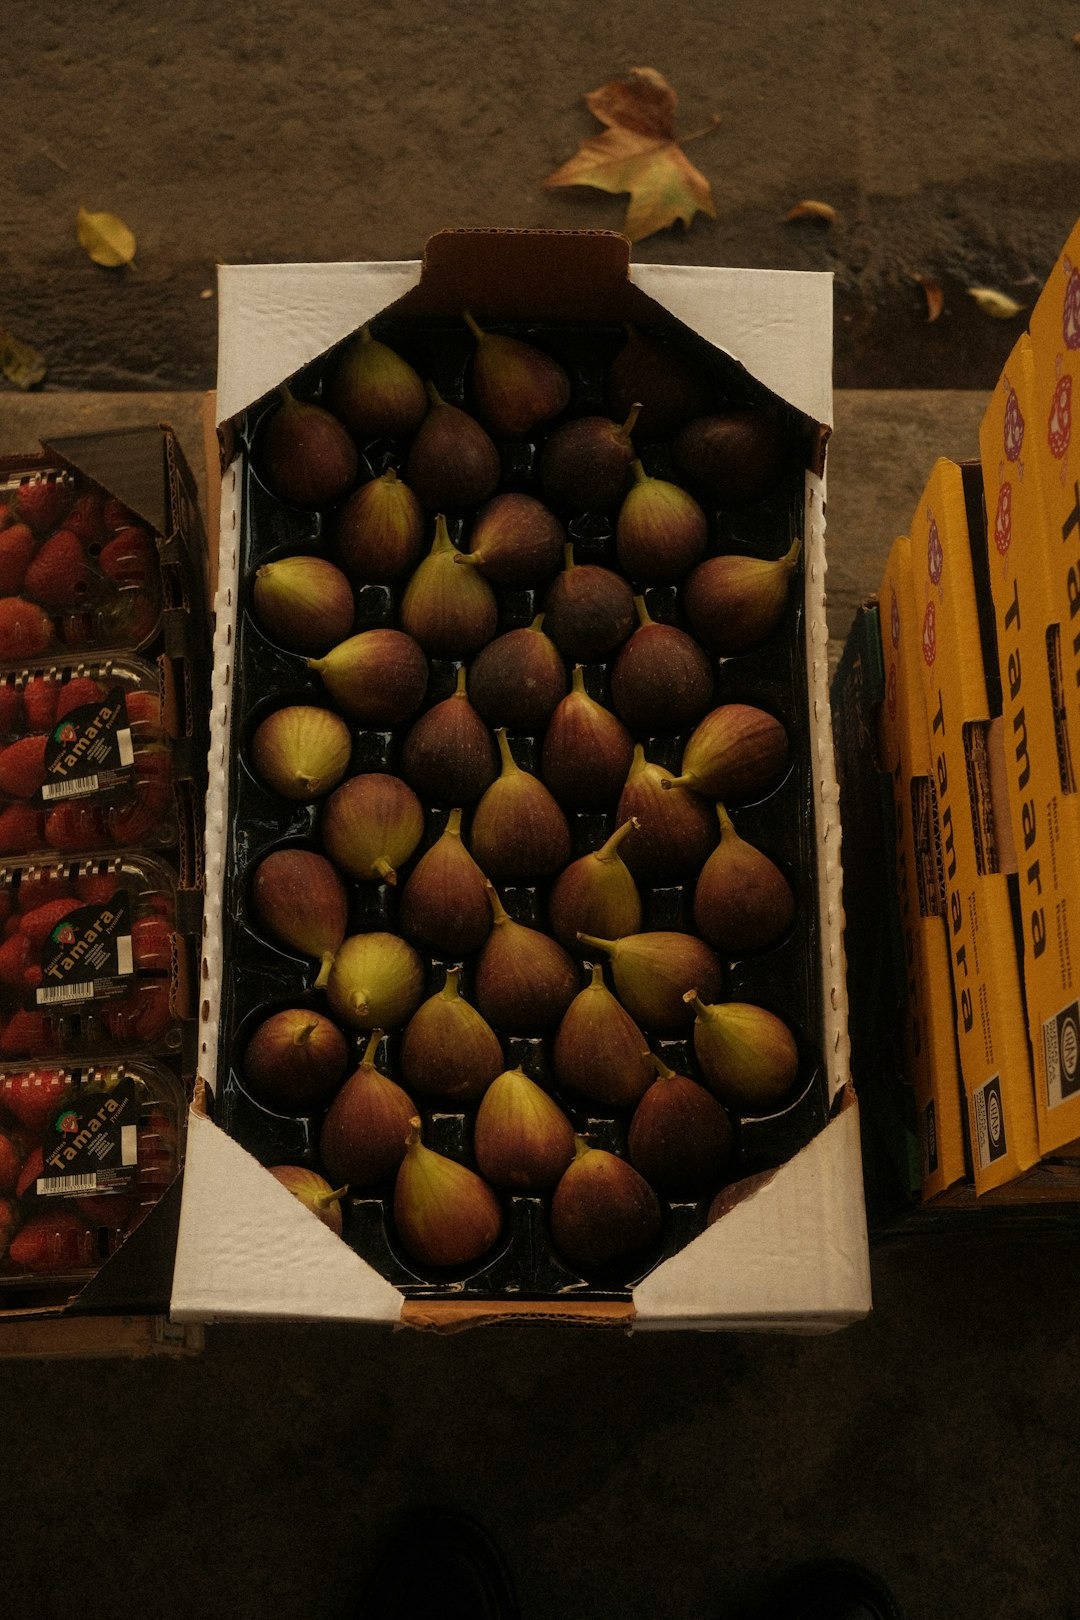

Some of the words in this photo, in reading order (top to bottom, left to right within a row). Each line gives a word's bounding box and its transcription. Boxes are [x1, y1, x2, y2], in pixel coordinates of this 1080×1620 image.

[49, 707, 113, 776] Tamara
[1005, 579, 1046, 959] Tamara
[932, 688, 973, 1034] Tamara
[48, 911, 114, 979] Tamara
[1061, 898, 1073, 990] Blackberries
[1064, 1031, 1075, 1068] IRAM
[49, 1098, 119, 1170] Tamara
